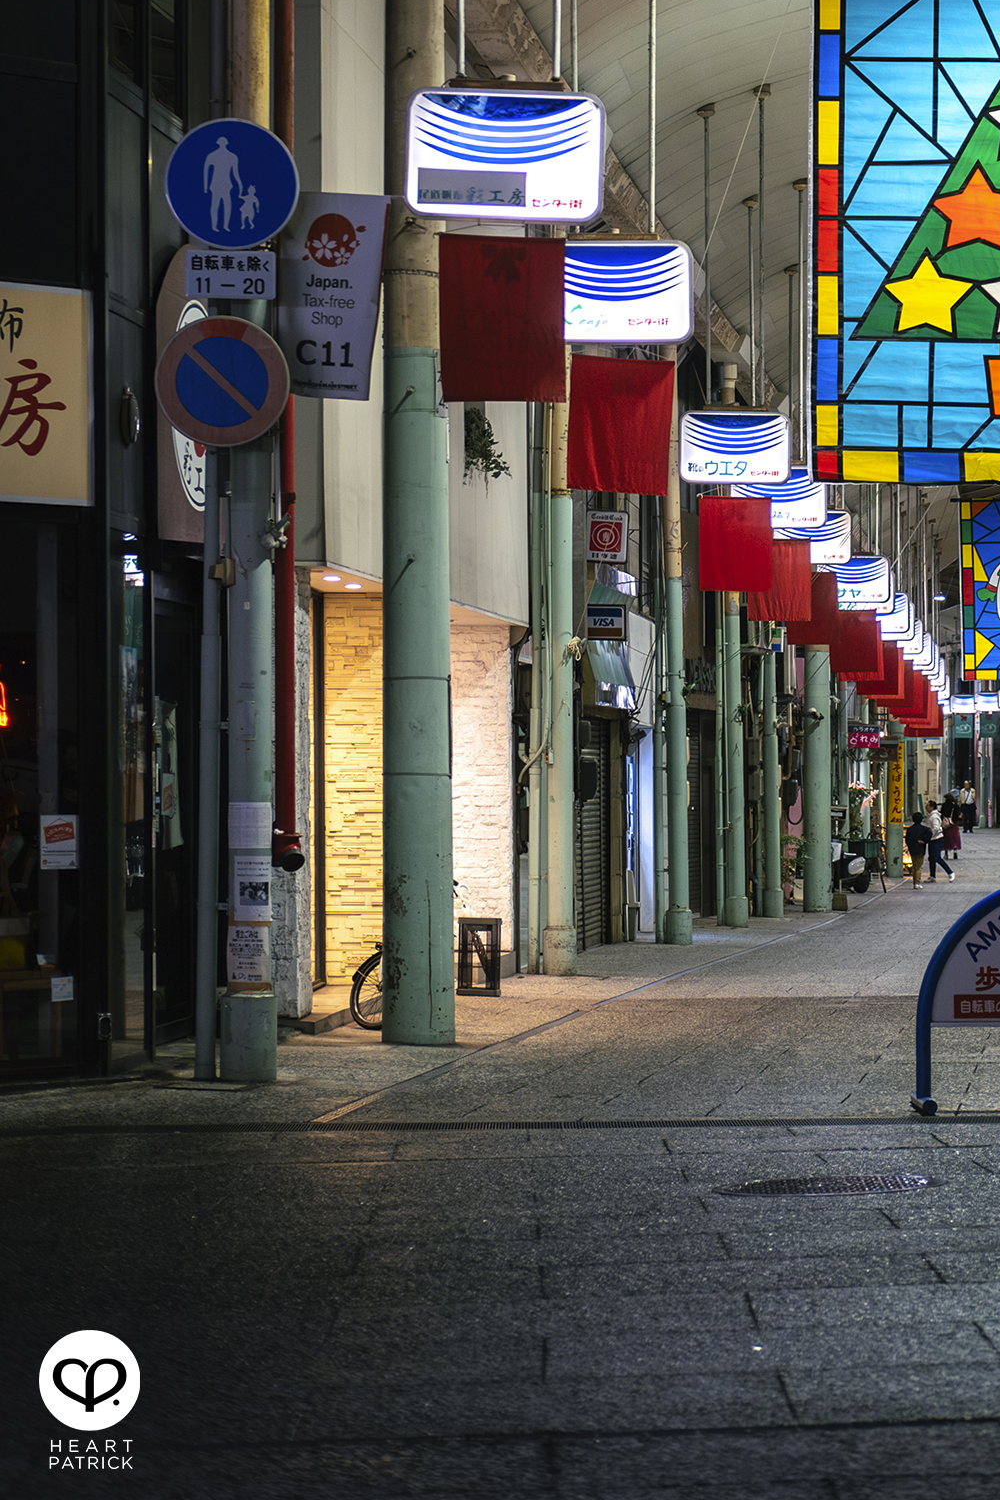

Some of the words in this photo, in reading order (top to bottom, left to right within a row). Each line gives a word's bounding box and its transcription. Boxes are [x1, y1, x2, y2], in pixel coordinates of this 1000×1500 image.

[532, 199, 583, 209] センター街
[191, 255, 270, 272] 自転車を除く
[196, 277, 211, 293] 11
[243, 278, 265, 294] 20
[306, 274, 353, 290] Japan.
[302, 293, 355, 309] Tax-free
[311, 311, 343, 328] Shop
[628, 318, 669, 326] センター街
[296, 339, 354, 368] C11
[0, 358, 66, 456] 房
[687, 461, 748, 476] 靴のウエタ
[593, 618, 614, 627] VISA
[850, 734, 878, 745] どれみ
